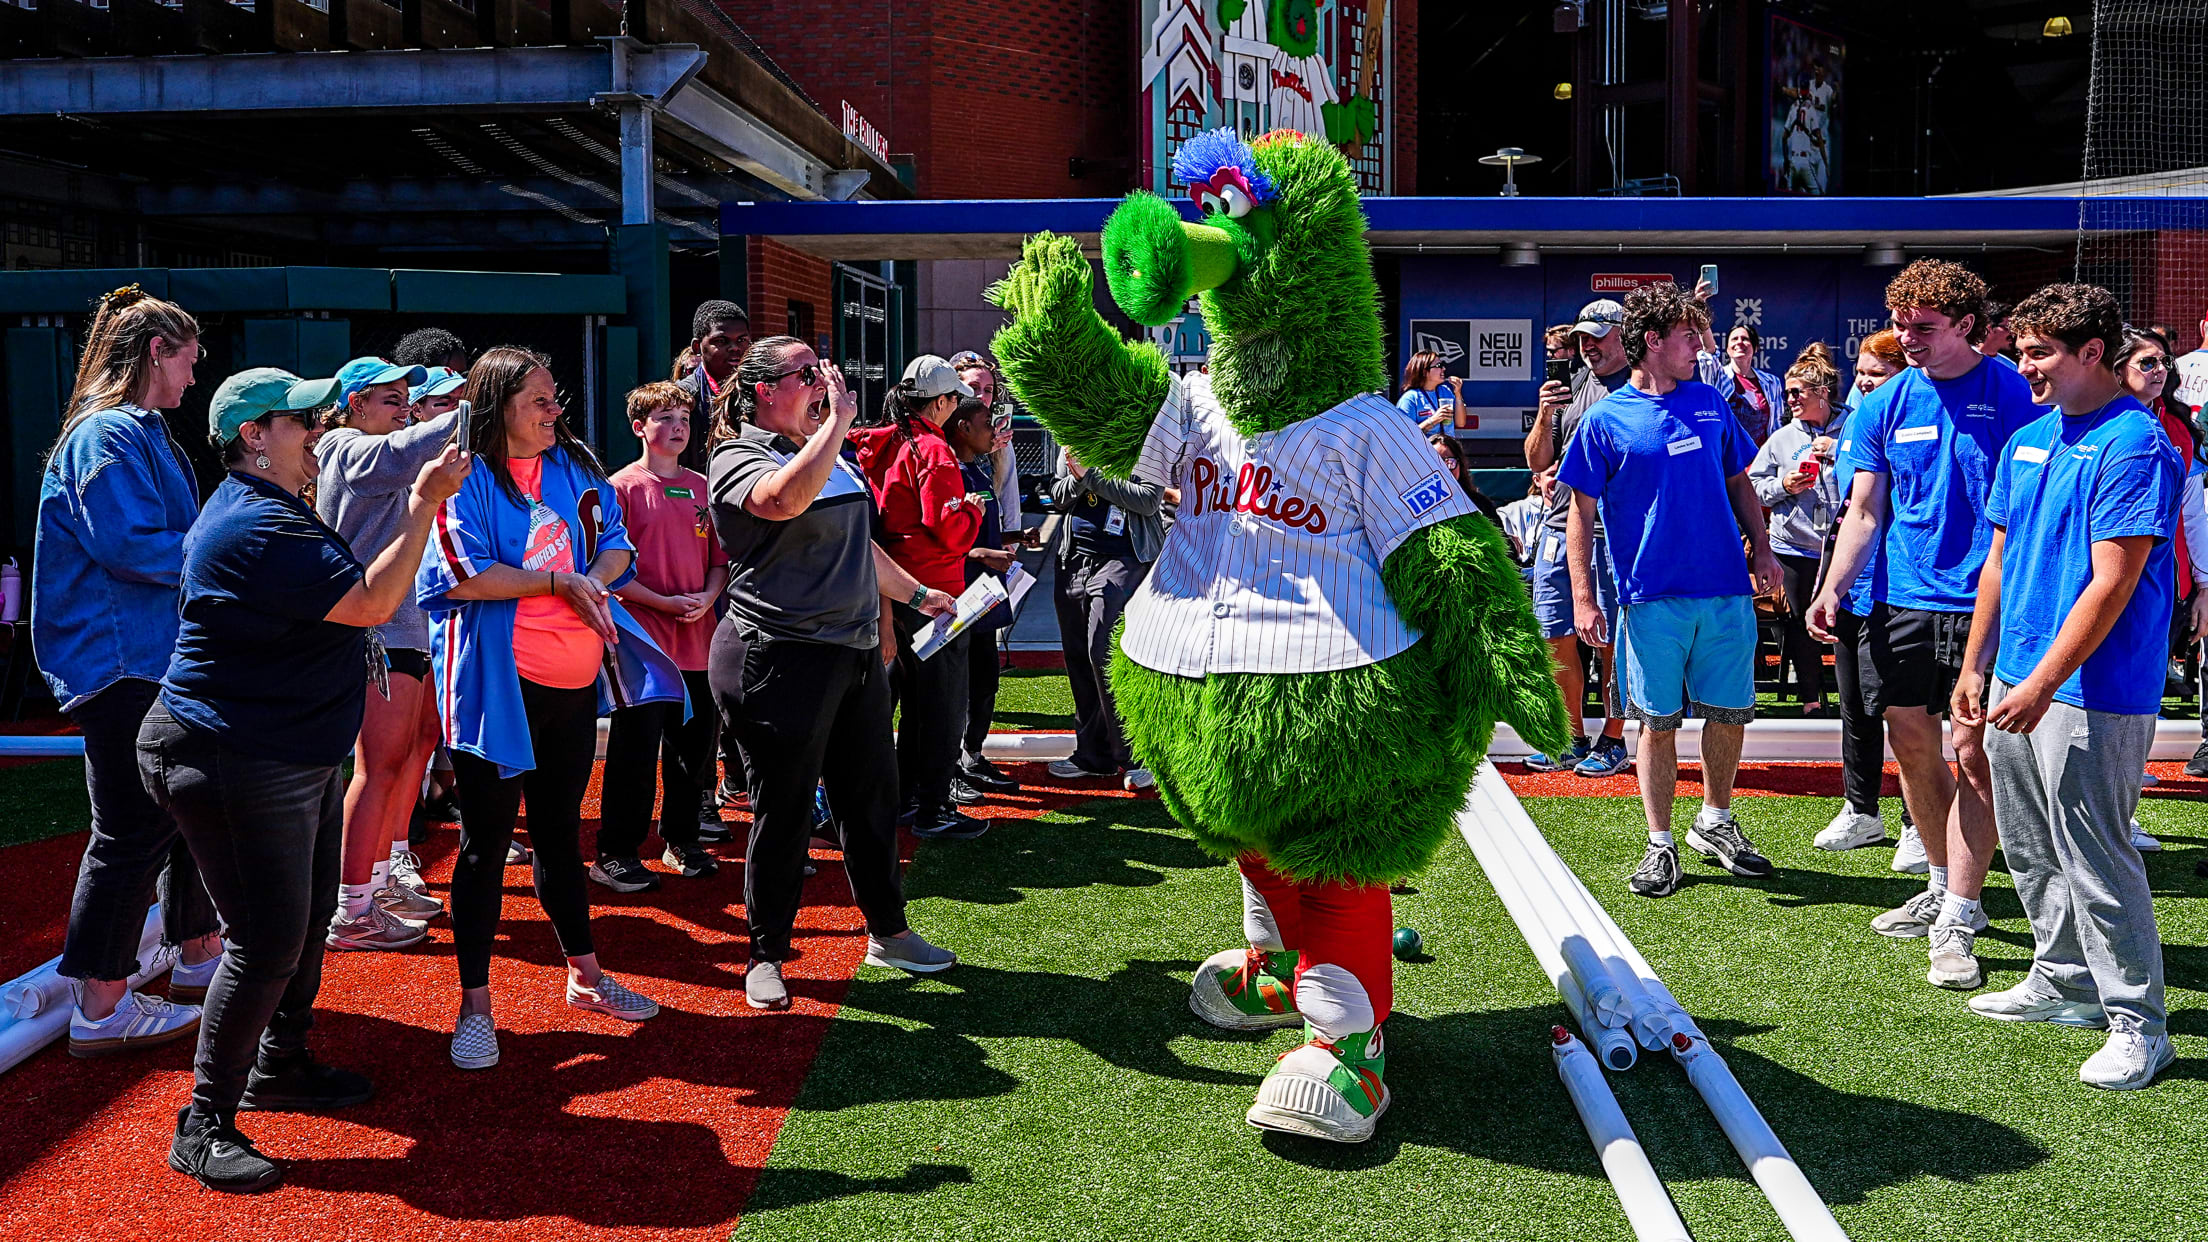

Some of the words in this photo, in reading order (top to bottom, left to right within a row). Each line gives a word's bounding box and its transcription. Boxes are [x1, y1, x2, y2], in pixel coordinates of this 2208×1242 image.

[841, 99, 859, 139] THE
[1595, 277, 1639, 289] phillies
[1847, 318, 1878, 334] THE
[1479, 333, 1522, 350] NEW
[1479, 351, 1522, 367] ERA
[1189, 456, 1327, 534] Phillies
[1406, 479, 1450, 515] IBX
